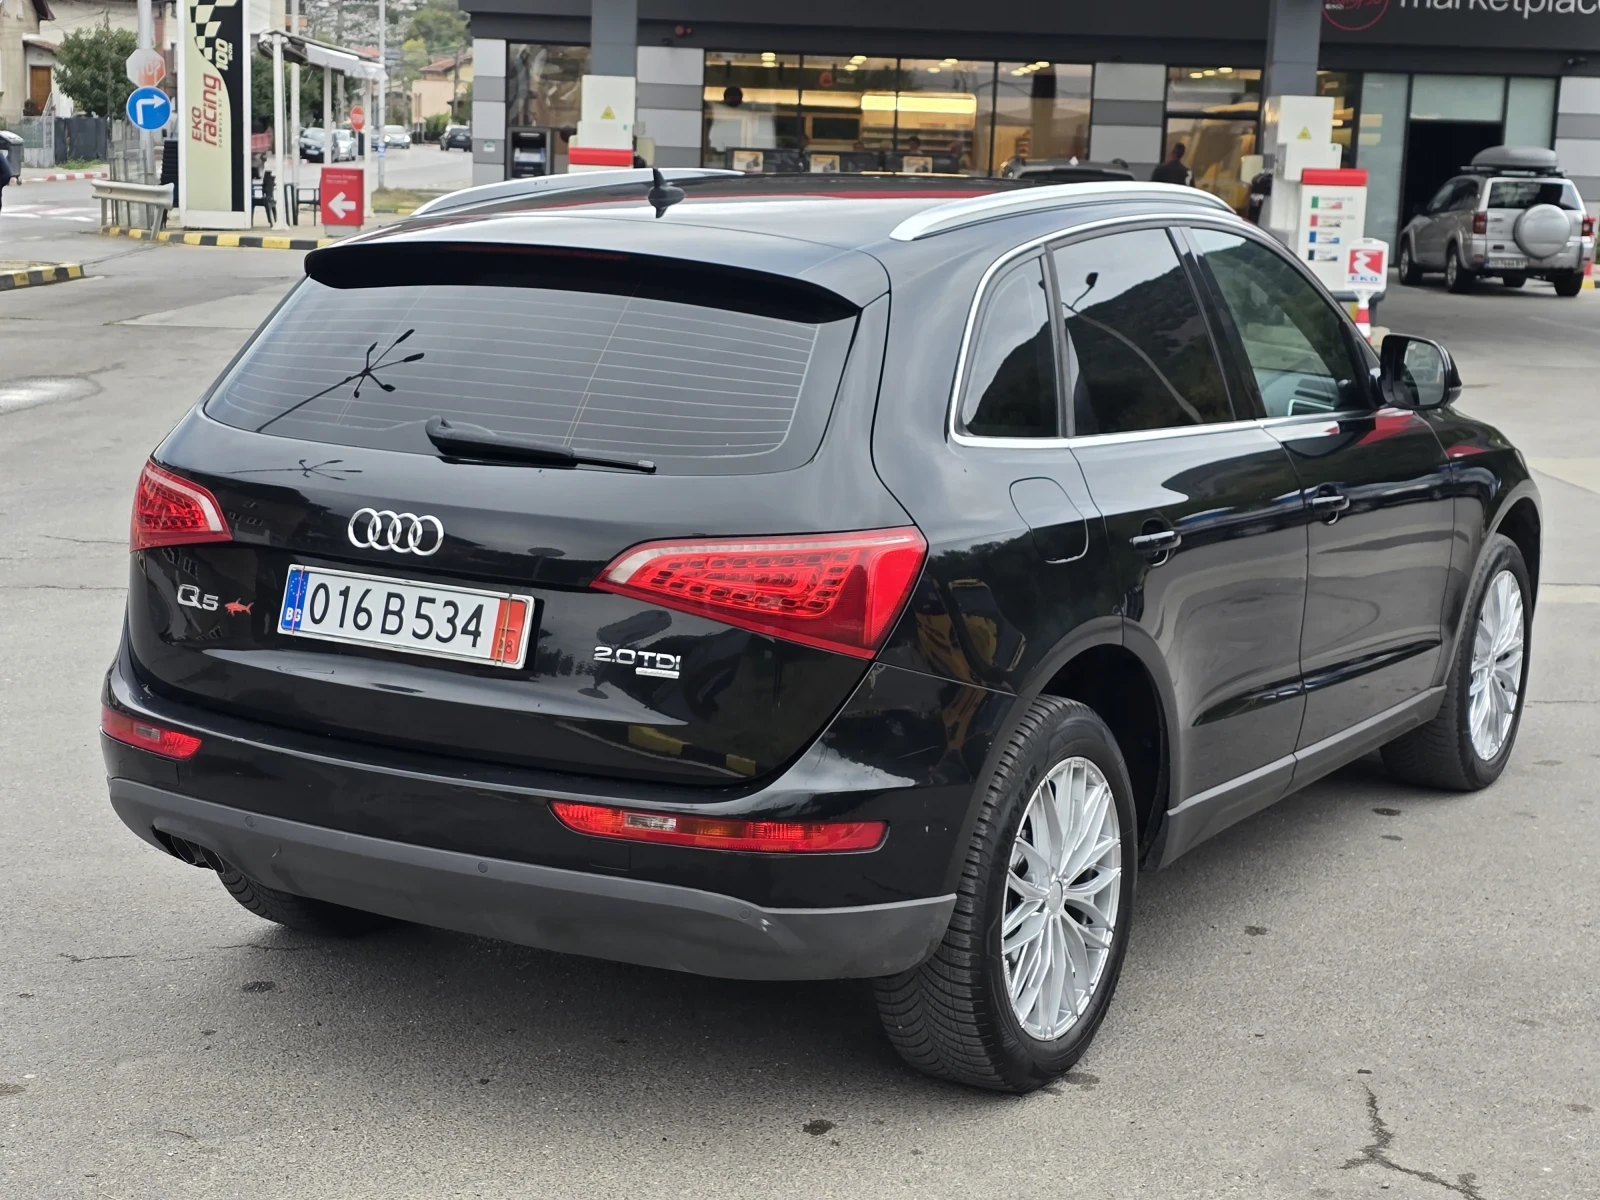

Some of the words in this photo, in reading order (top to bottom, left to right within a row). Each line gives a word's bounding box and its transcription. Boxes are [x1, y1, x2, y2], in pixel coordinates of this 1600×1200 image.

[1400, 0, 1600, 20] aretplac
[215, 38, 229, 71] 100
[192, 106, 202, 142] EKO
[203, 73, 222, 147] racing
[177, 584, 219, 611] Q5
[285, 607, 302, 622] BG
